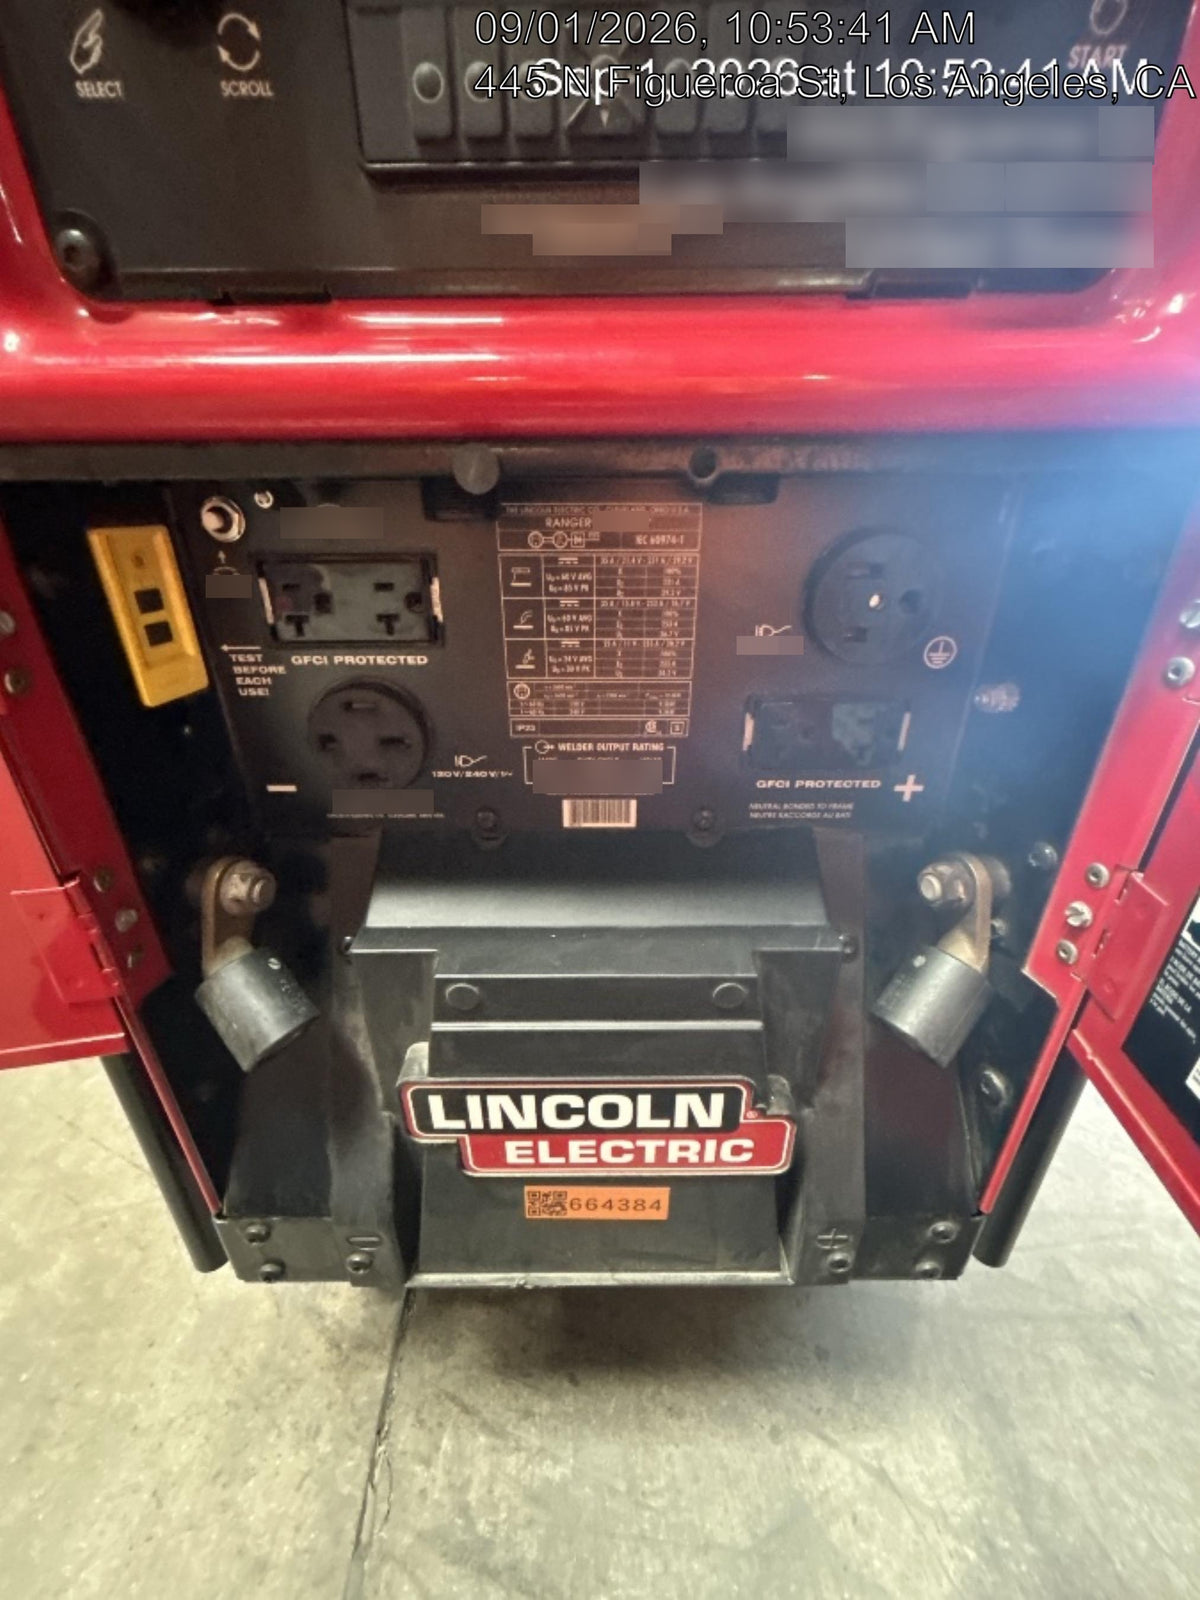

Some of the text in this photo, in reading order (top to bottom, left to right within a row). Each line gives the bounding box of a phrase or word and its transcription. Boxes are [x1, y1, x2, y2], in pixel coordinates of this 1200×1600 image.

[1067, 44, 1128, 70] START
[76, 80, 124, 98] SELECT
[219, 80, 274, 98] SCROLL
[545, 517, 592, 528] RANGER
[229, 653, 263, 662] TEST
[291, 655, 429, 666] GFCI PROTECTED
[233, 665, 287, 675] BEFORE
[235, 676, 273, 686] EACH
[238, 687, 270, 697] USE!
[557, 742, 665, 752] WELDER OUTPUT RATING
[756, 779, 882, 789] GFCI PROTECTED
[427, 1093, 725, 1130] LINCOLN
[504, 1138, 755, 1164] ELECTRIC
[569, 1197, 663, 1212] 664384
